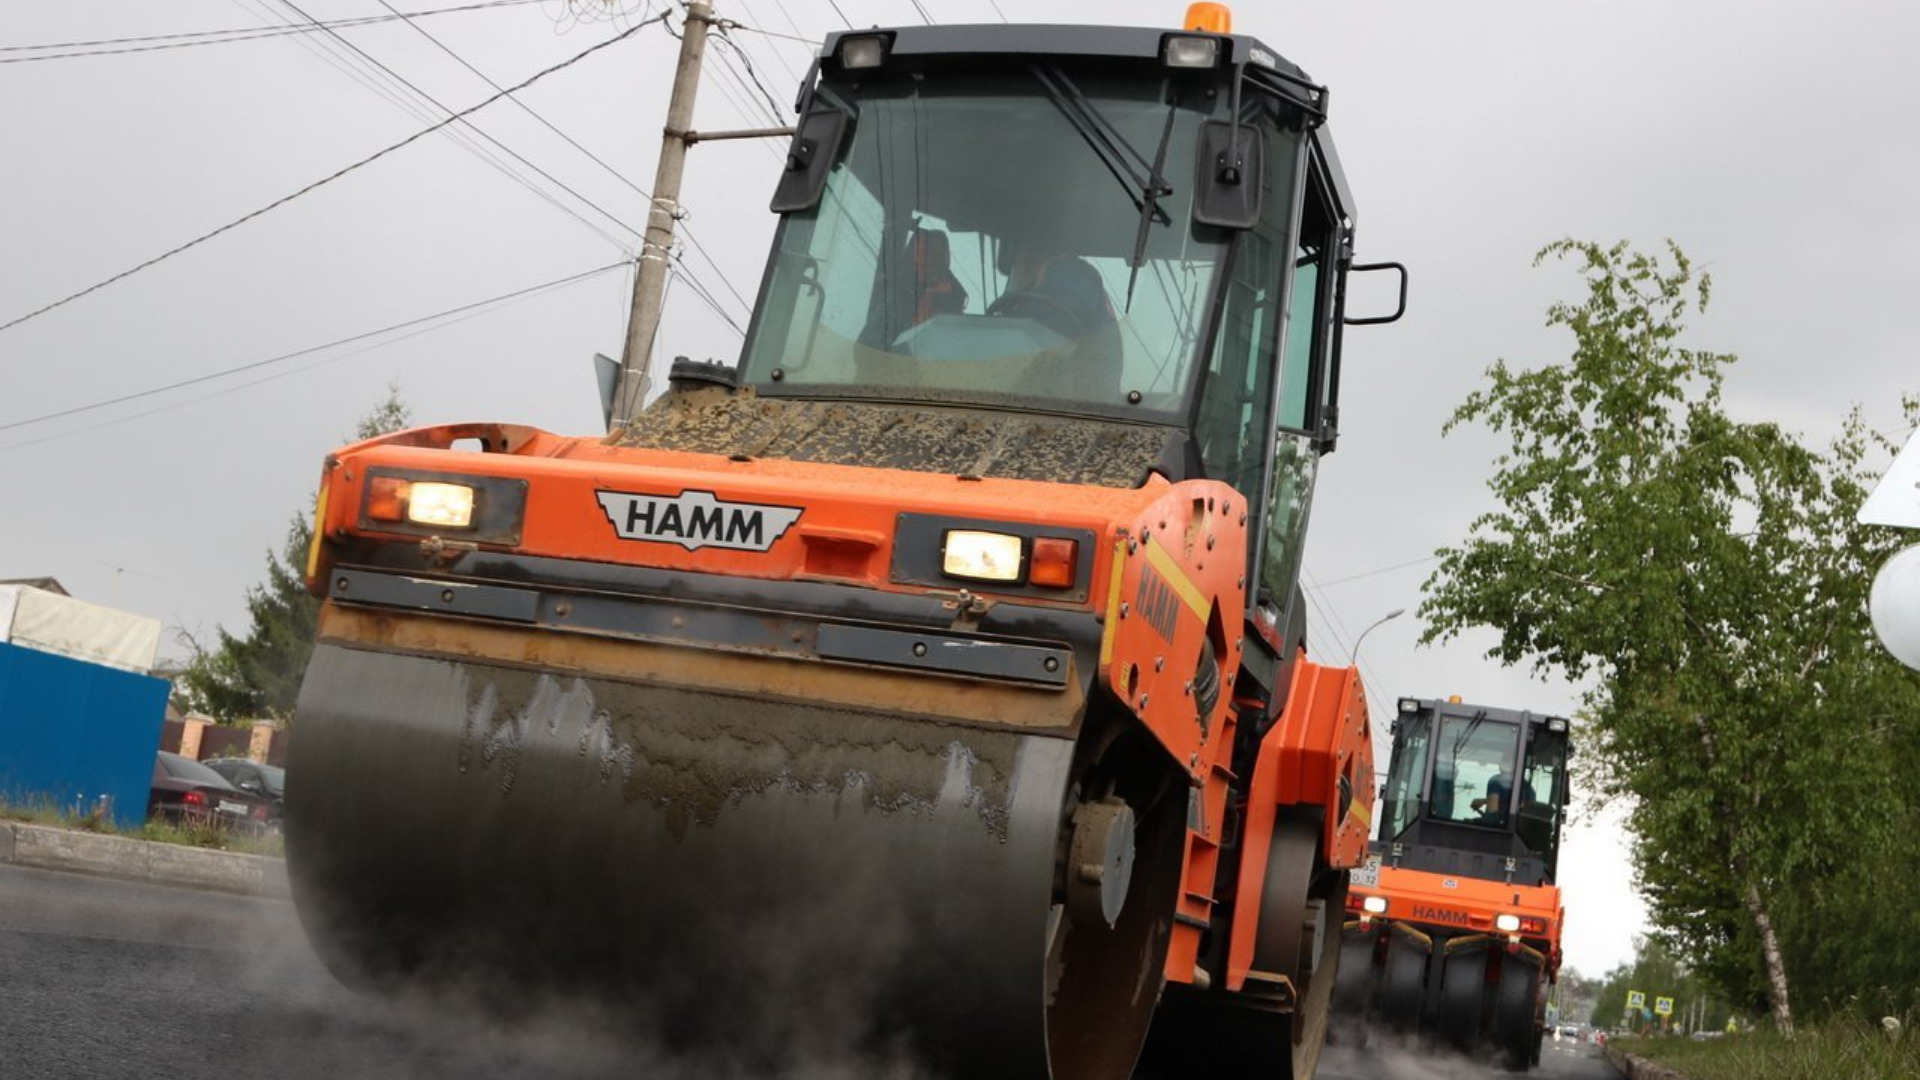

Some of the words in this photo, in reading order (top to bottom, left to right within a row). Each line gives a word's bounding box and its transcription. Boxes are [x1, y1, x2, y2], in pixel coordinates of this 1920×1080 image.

[626, 500, 763, 545] HAMM
[1134, 563, 1179, 647] HAMM
[1412, 905, 1468, 925] HAMM
